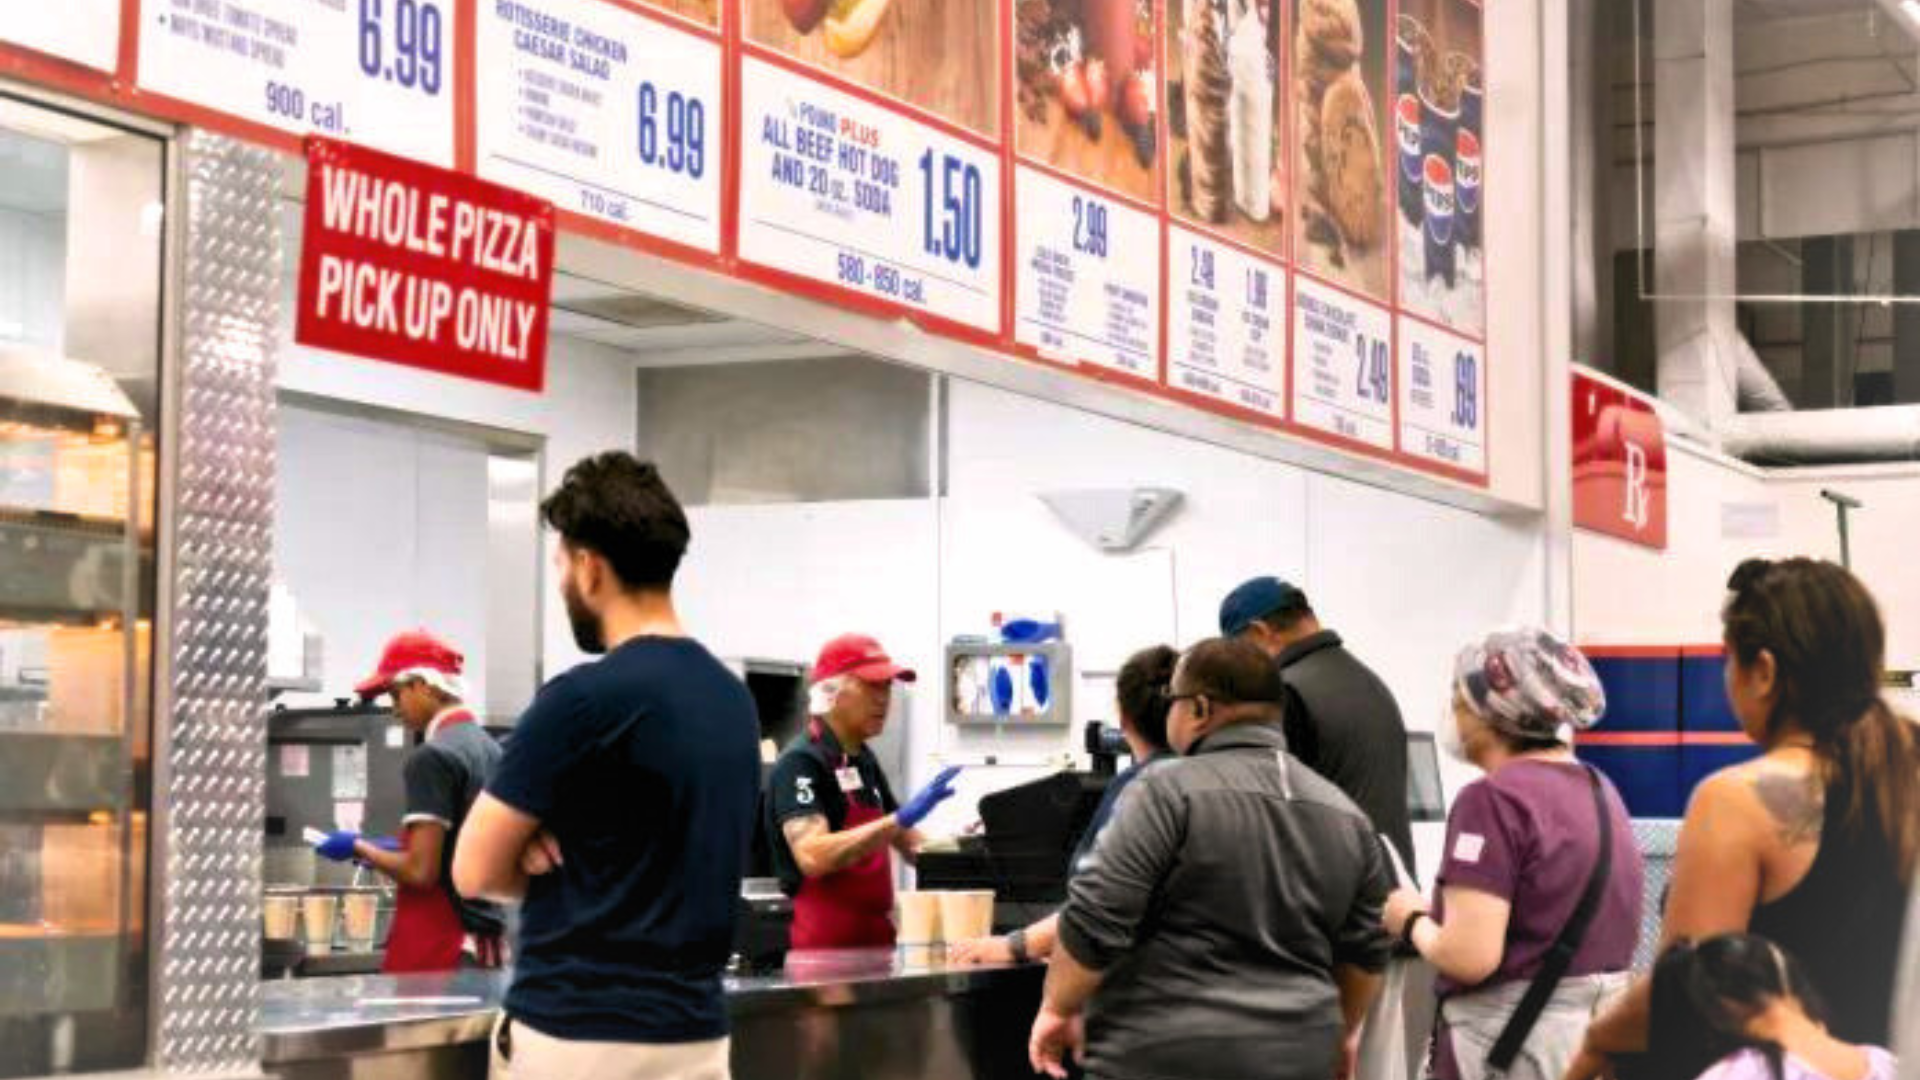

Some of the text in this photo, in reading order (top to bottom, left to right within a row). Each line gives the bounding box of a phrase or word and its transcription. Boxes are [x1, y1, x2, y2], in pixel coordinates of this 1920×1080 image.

[359, 0, 441, 95] 6.99
[495, 0, 628, 64] ROTISSERIE CHICKEN
[514, 29, 610, 81] CAESAR SALAD
[266, 80, 350, 133] 900 cal.
[638, 80, 704, 179] 6.99
[840, 117, 879, 148] PLUS
[762, 114, 899, 189] ALL BEEF HOT DOG
[772, 151, 803, 188] AND
[808, 164, 828, 195] 20
[855, 179, 892, 217] SODA
[322, 163, 538, 282] WHOLE PIZZA
[581, 189, 605, 214] 710
[919, 146, 981, 269] 1.50
[1072, 195, 1107, 258] 2.99
[317, 253, 536, 362] PICK UP ONLY
